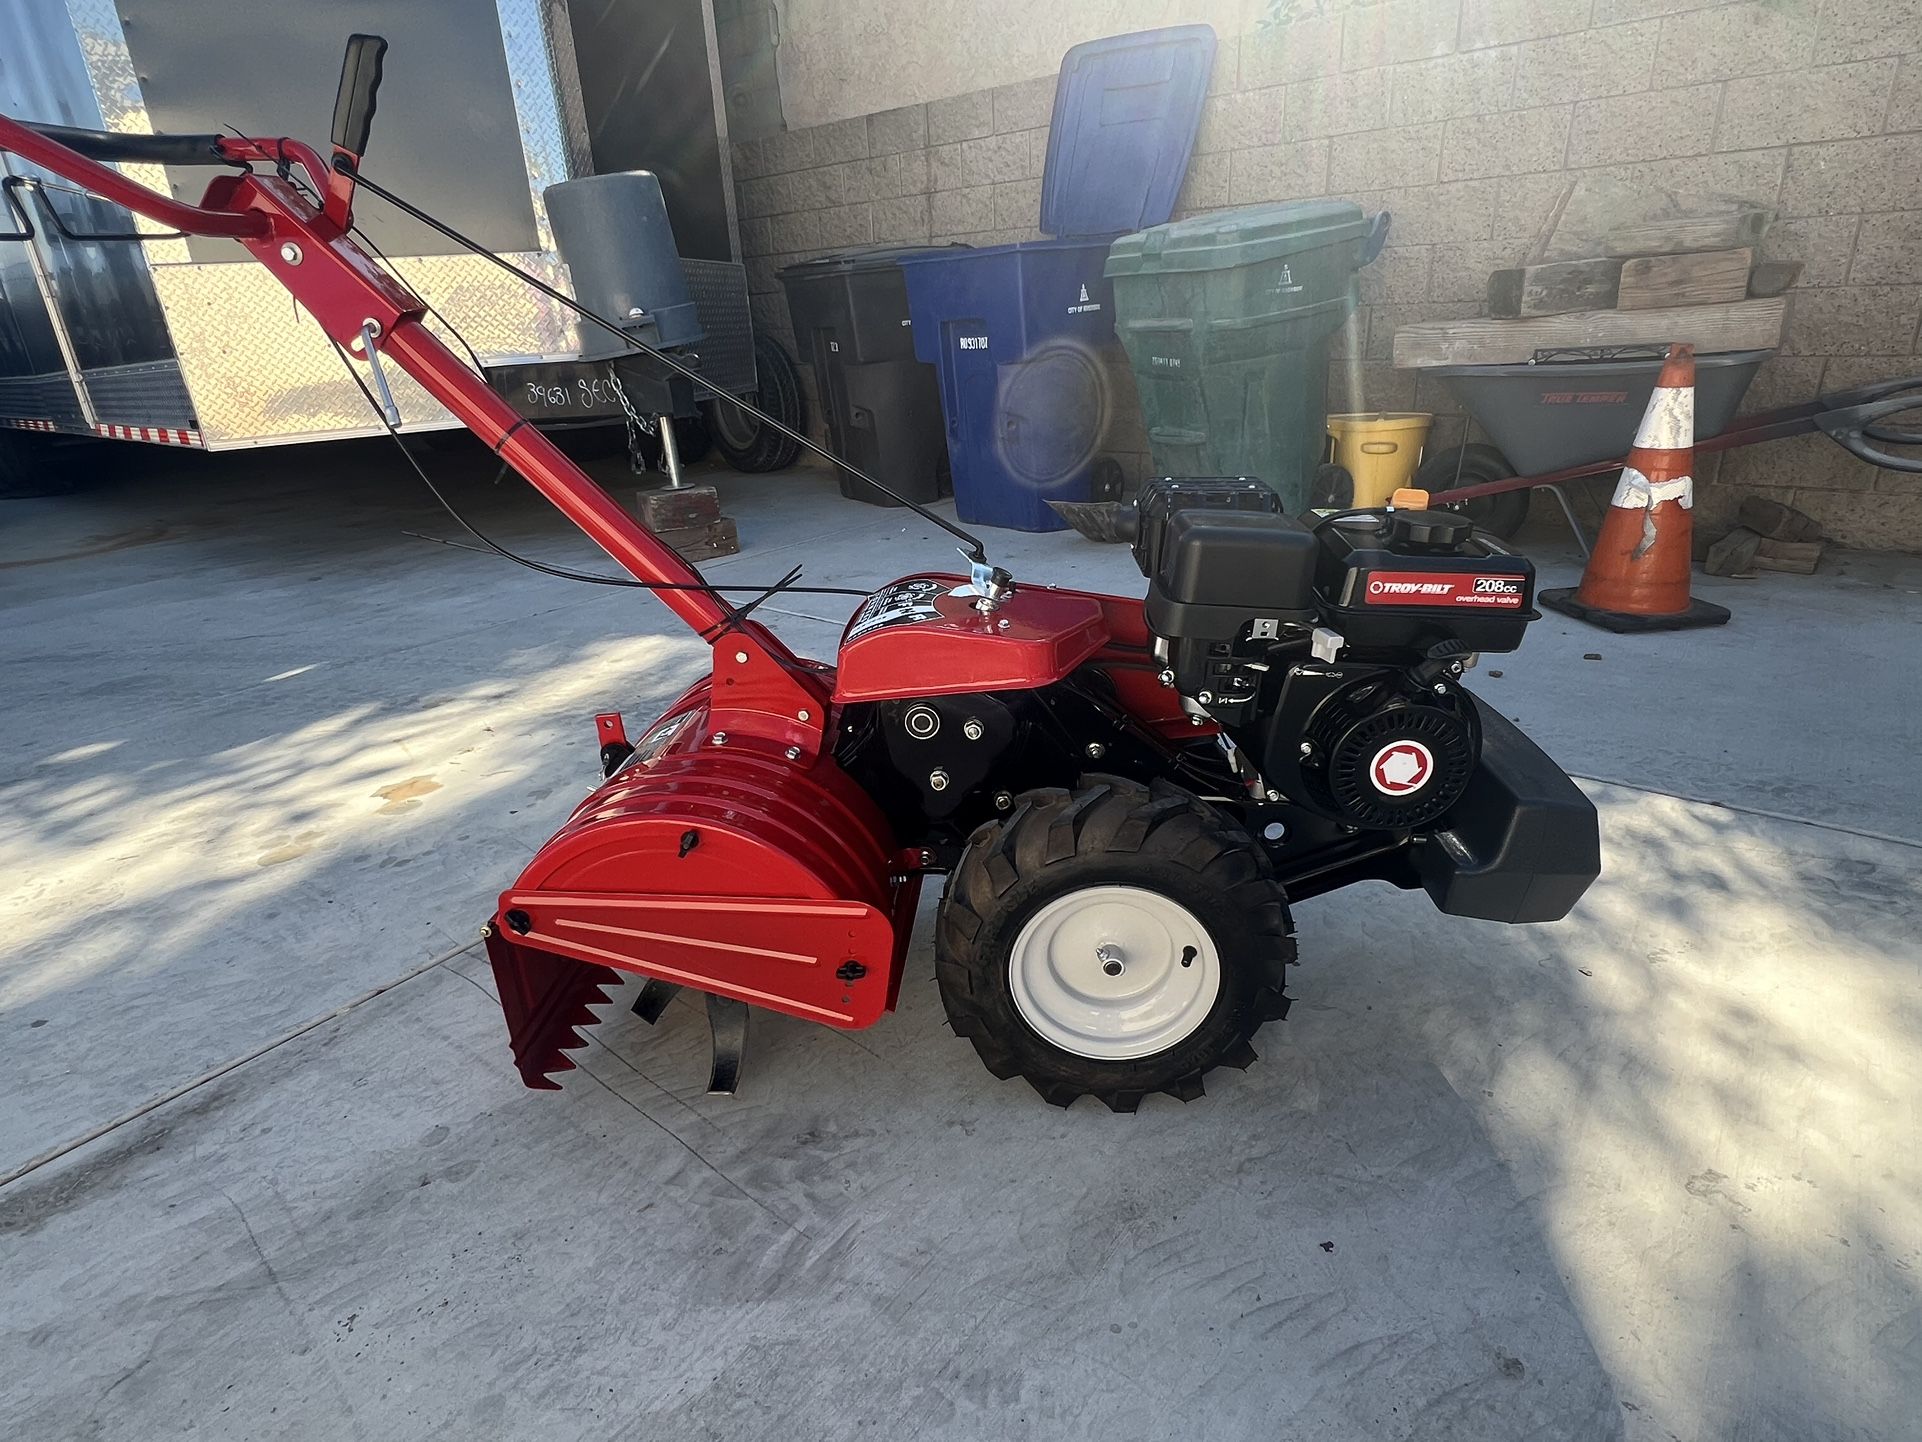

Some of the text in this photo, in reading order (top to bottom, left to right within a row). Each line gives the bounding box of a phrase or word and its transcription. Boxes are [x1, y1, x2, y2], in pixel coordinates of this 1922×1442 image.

[526, 382, 572, 408] 39631
[1383, 579, 1518, 595] TROY-BILT 208cc
[1455, 594, 1520, 604] overhead valve
